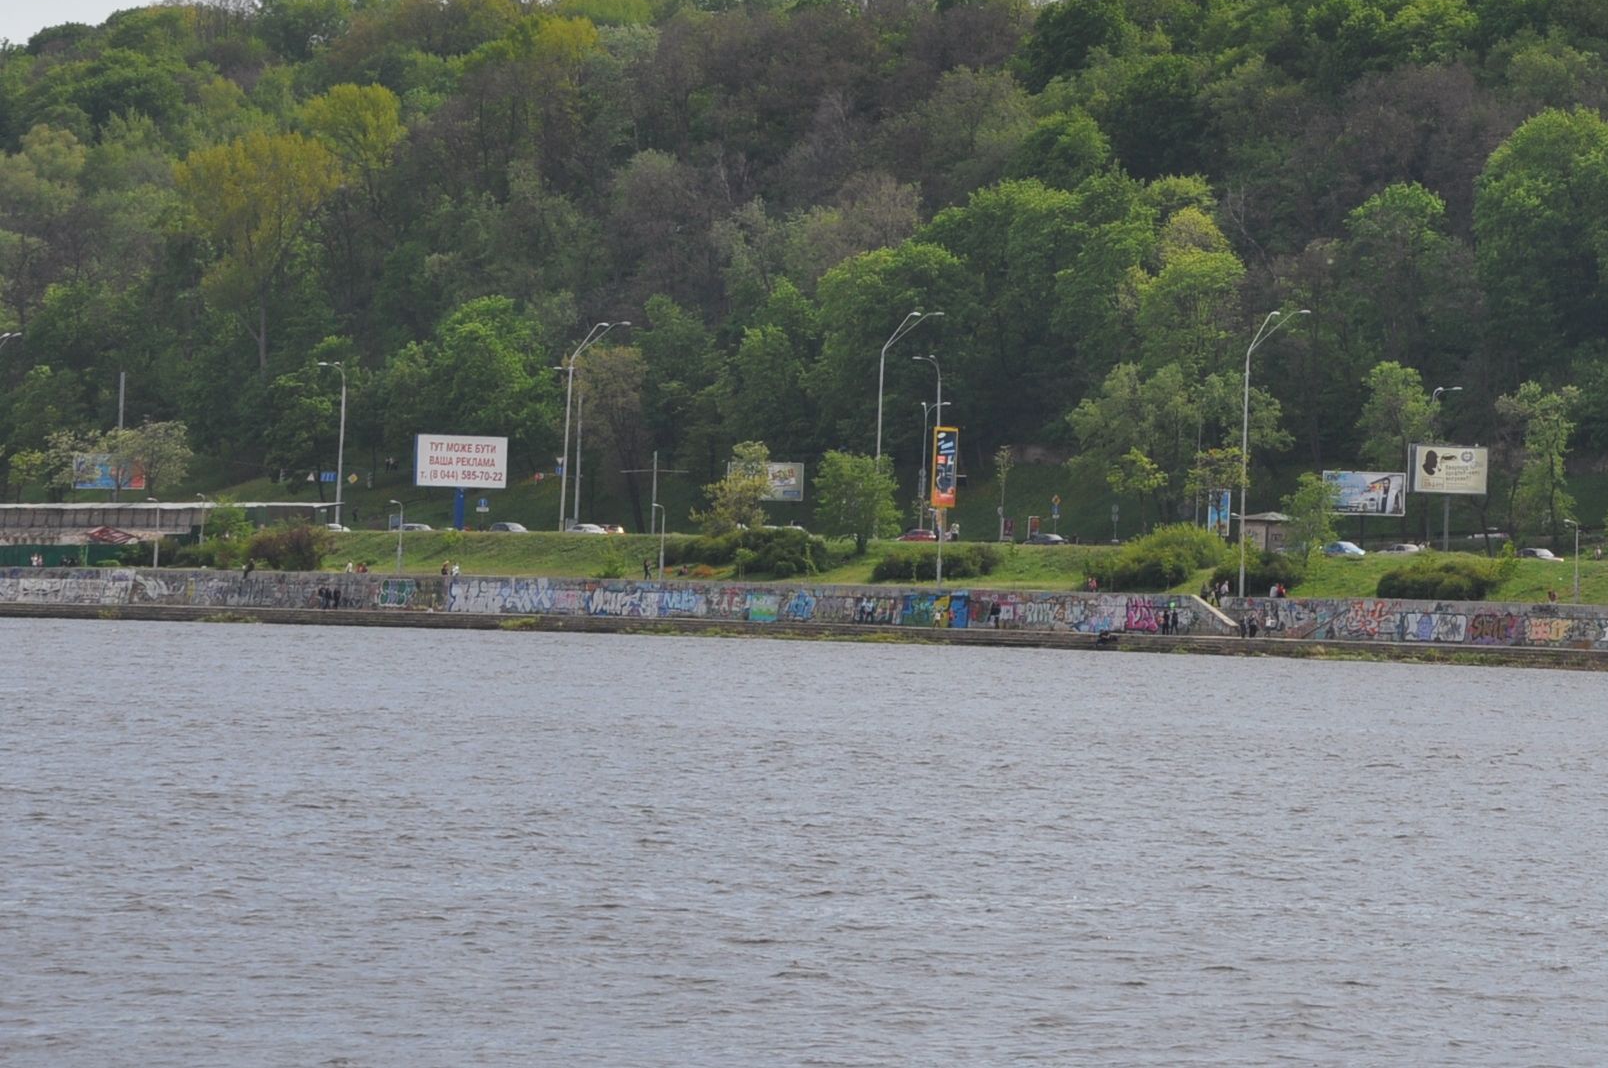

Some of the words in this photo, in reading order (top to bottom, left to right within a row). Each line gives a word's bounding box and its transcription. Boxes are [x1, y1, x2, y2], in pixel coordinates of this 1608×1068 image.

[430, 442, 443, 452] ТУТ
[446, 443, 472, 453] МОЖЕ
[475, 444, 496, 454] БУТИ
[429, 455, 453, 466] ВАША
[456, 457, 495, 468] РЕКЛАМА
